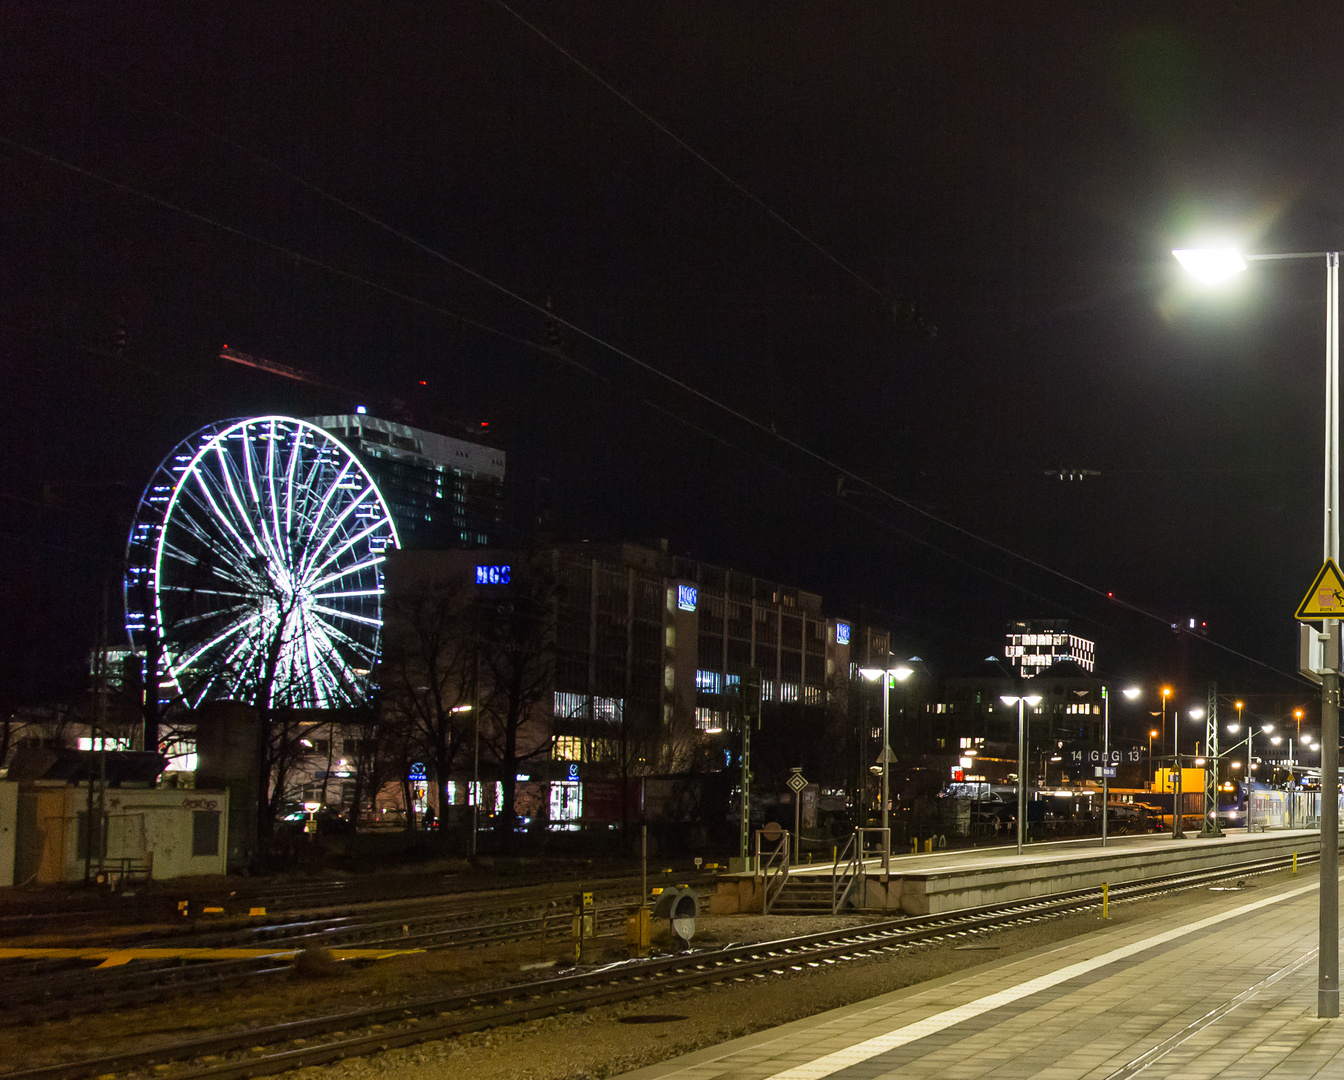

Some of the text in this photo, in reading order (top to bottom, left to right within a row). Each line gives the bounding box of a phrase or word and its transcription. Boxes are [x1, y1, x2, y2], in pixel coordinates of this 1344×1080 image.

[1071, 750, 1140, 762] 14 G G 13
